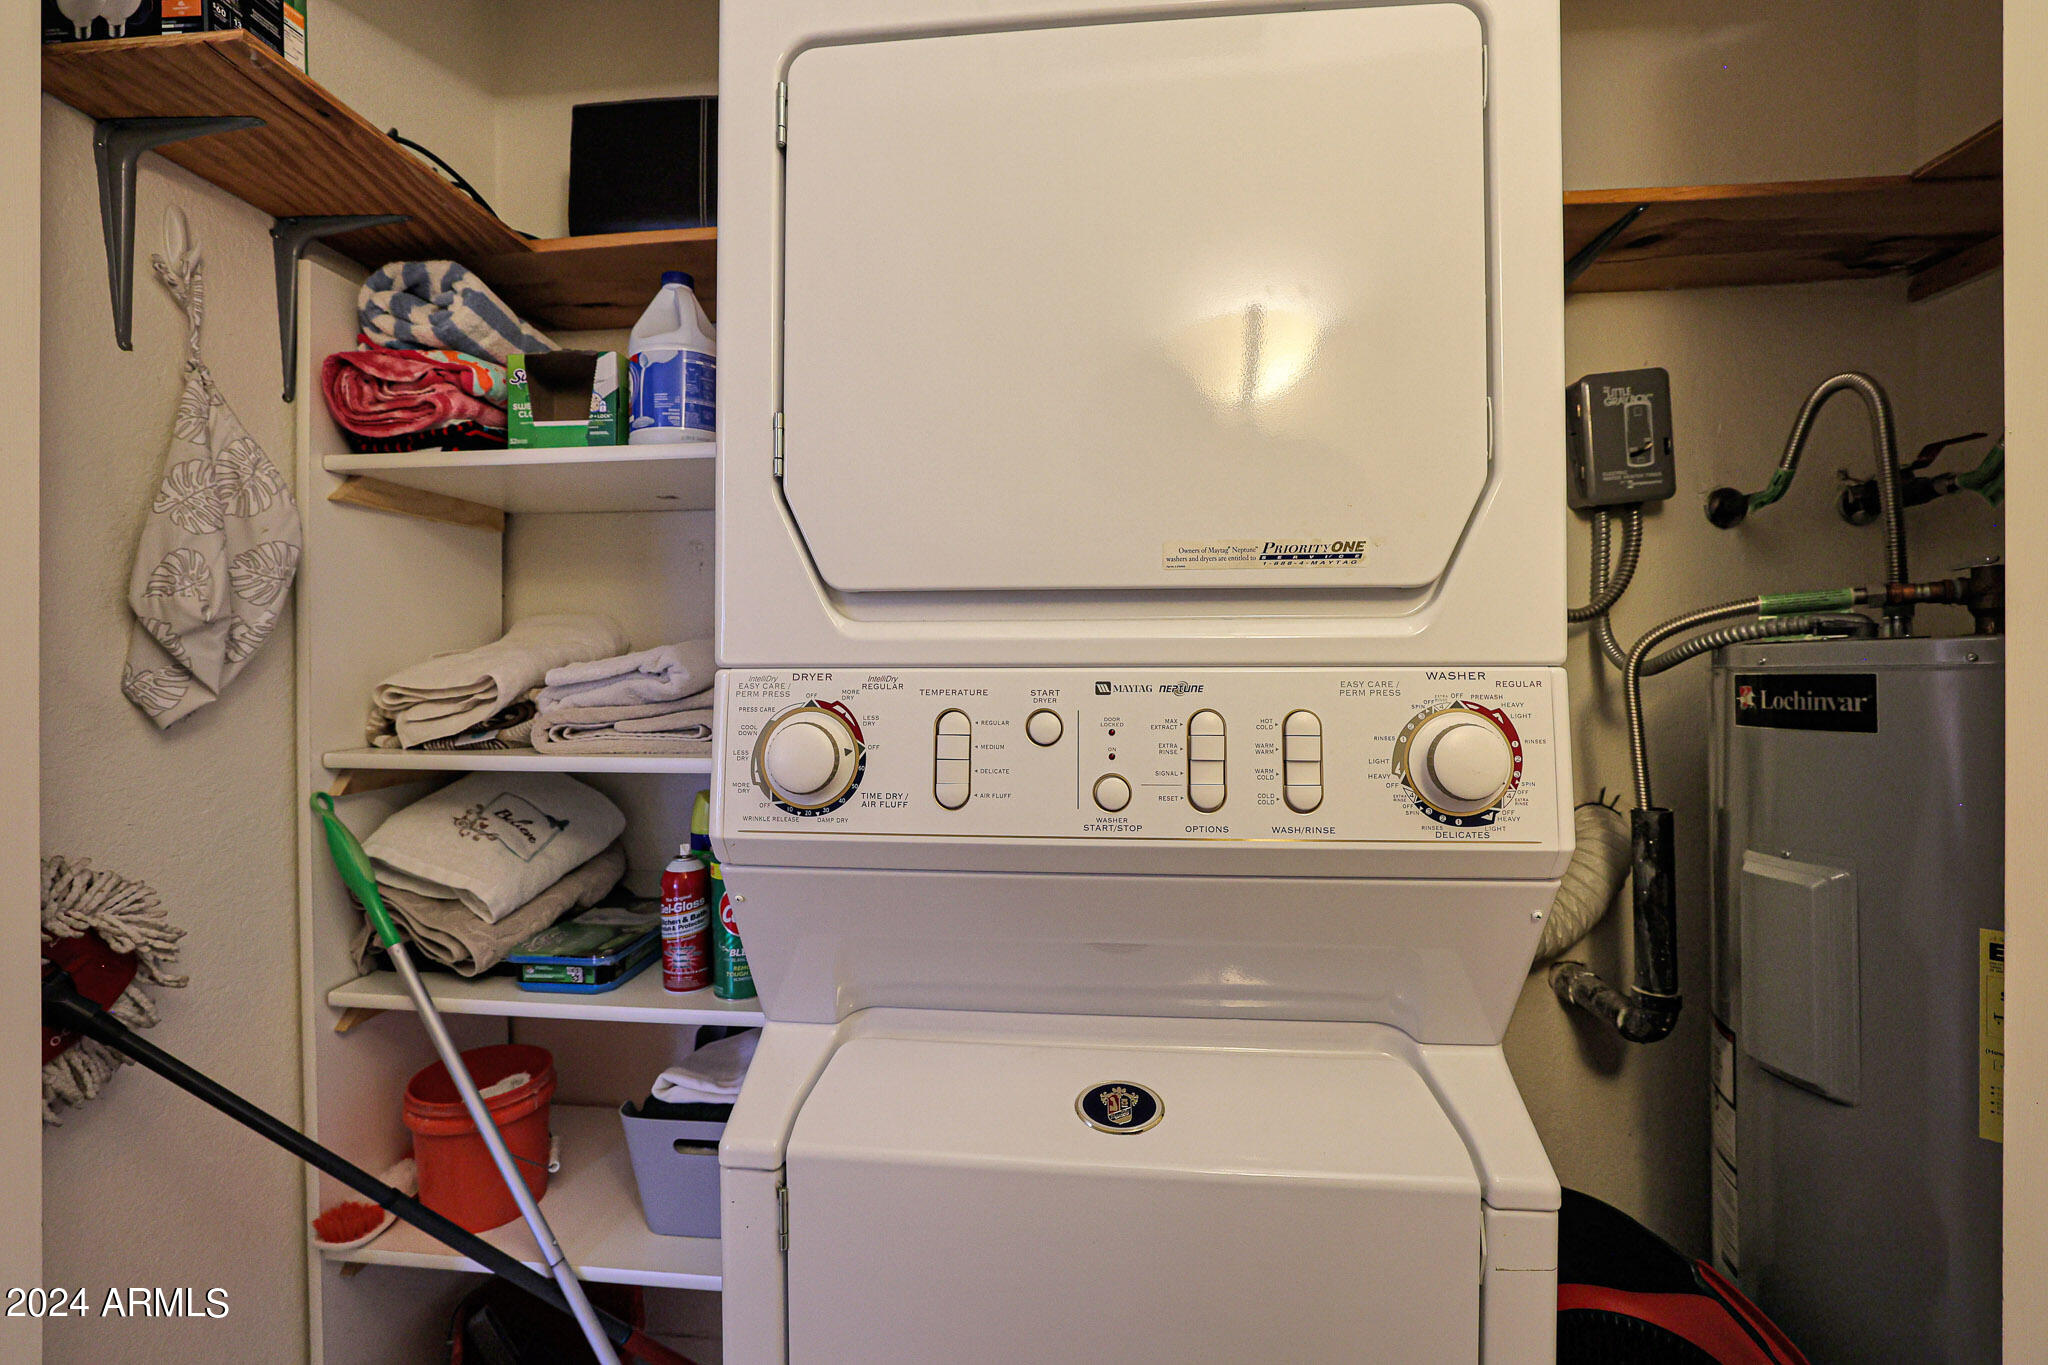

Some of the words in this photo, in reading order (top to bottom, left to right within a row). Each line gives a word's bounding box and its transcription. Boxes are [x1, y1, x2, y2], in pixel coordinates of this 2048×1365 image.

[1208, 546, 1230, 554] Maytag
[1232, 546, 1257, 554] Neptune
[1200, 555, 1217, 563] dryers
[792, 673, 833, 681] DRYER
[867, 675, 899, 684] IntelliDry
[1426, 671, 1486, 681] WASHER
[1495, 680, 1542, 688] REGULAR
[1113, 684, 1153, 693] MAYTAG
[1030, 689, 1061, 697] START
[1760, 689, 1868, 712] Lochinvar
[861, 792, 883, 800] TIME
[879, 801, 909, 809] FLUFF
[494, 808, 537, 844] Believe
[1083, 824, 1143, 833] START/STOP
[1185, 825, 1229, 833] OPTIONS
[1271, 826, 1336, 835] WASH/RINSE
[1435, 831, 1490, 839] DELICATES
